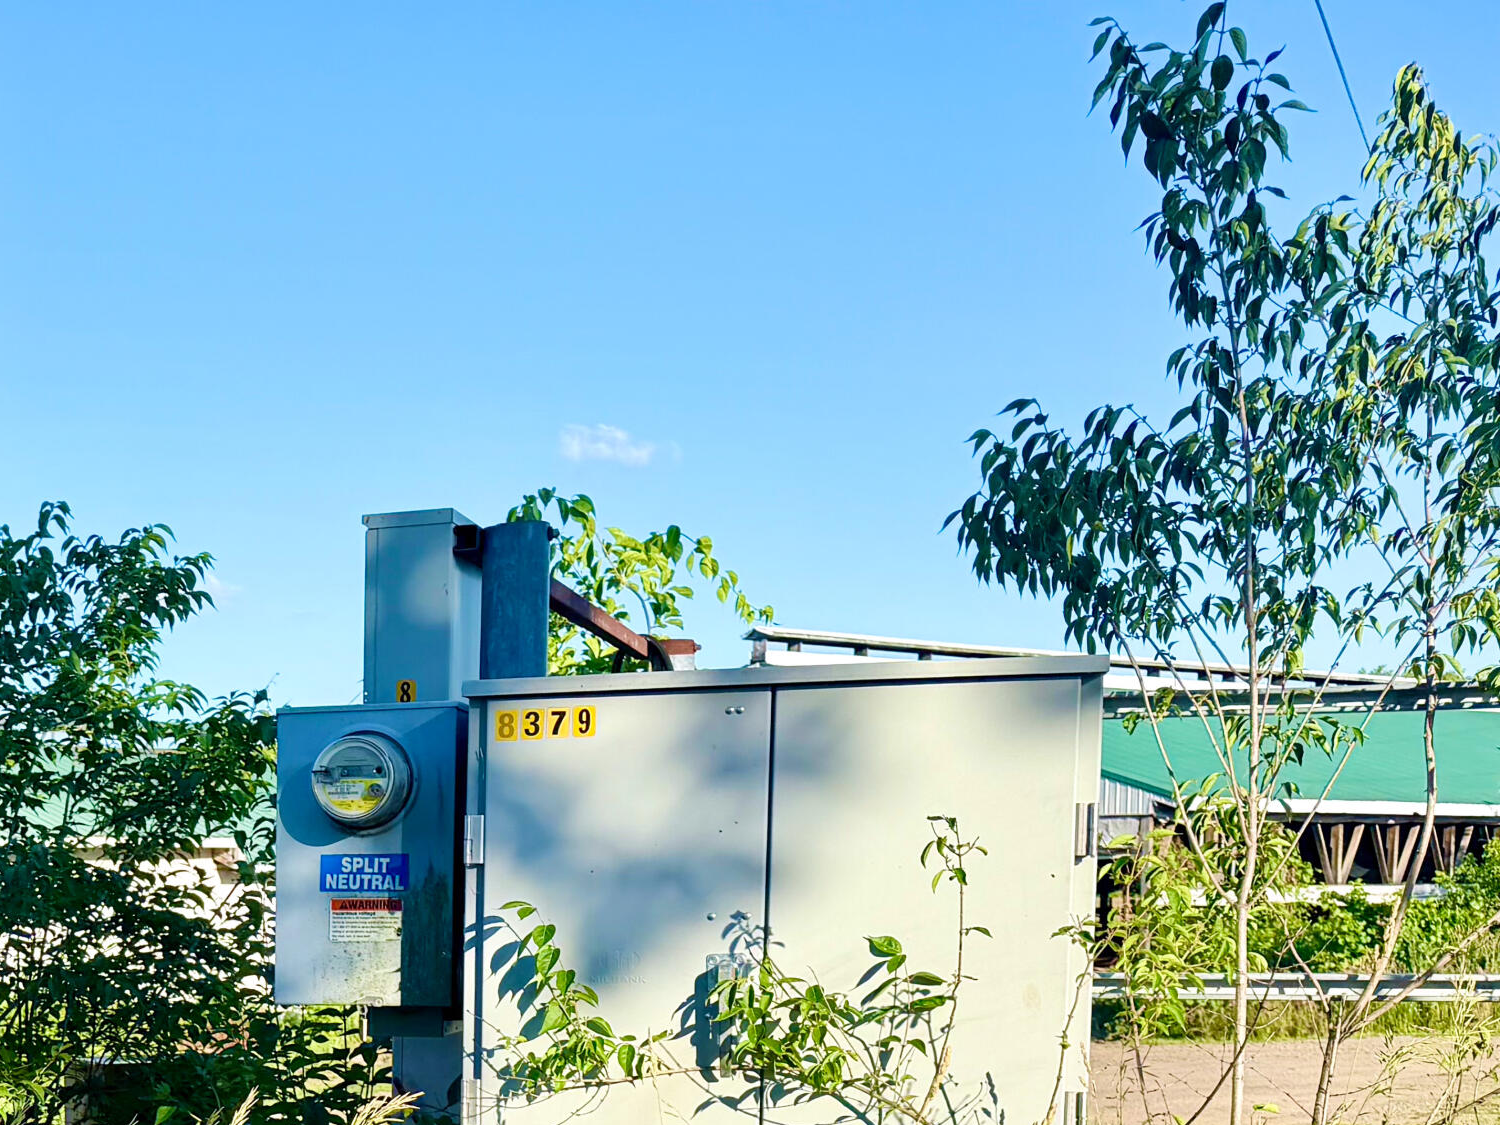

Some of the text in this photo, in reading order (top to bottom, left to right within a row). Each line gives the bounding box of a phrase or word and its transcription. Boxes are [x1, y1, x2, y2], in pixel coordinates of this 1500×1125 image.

[400, 681, 411, 702] 8
[498, 708, 591, 738] 8379
[341, 856, 390, 873] SPLIT
[325, 873, 404, 890] NEUTRAL
[349, 899, 398, 909] WARNING
